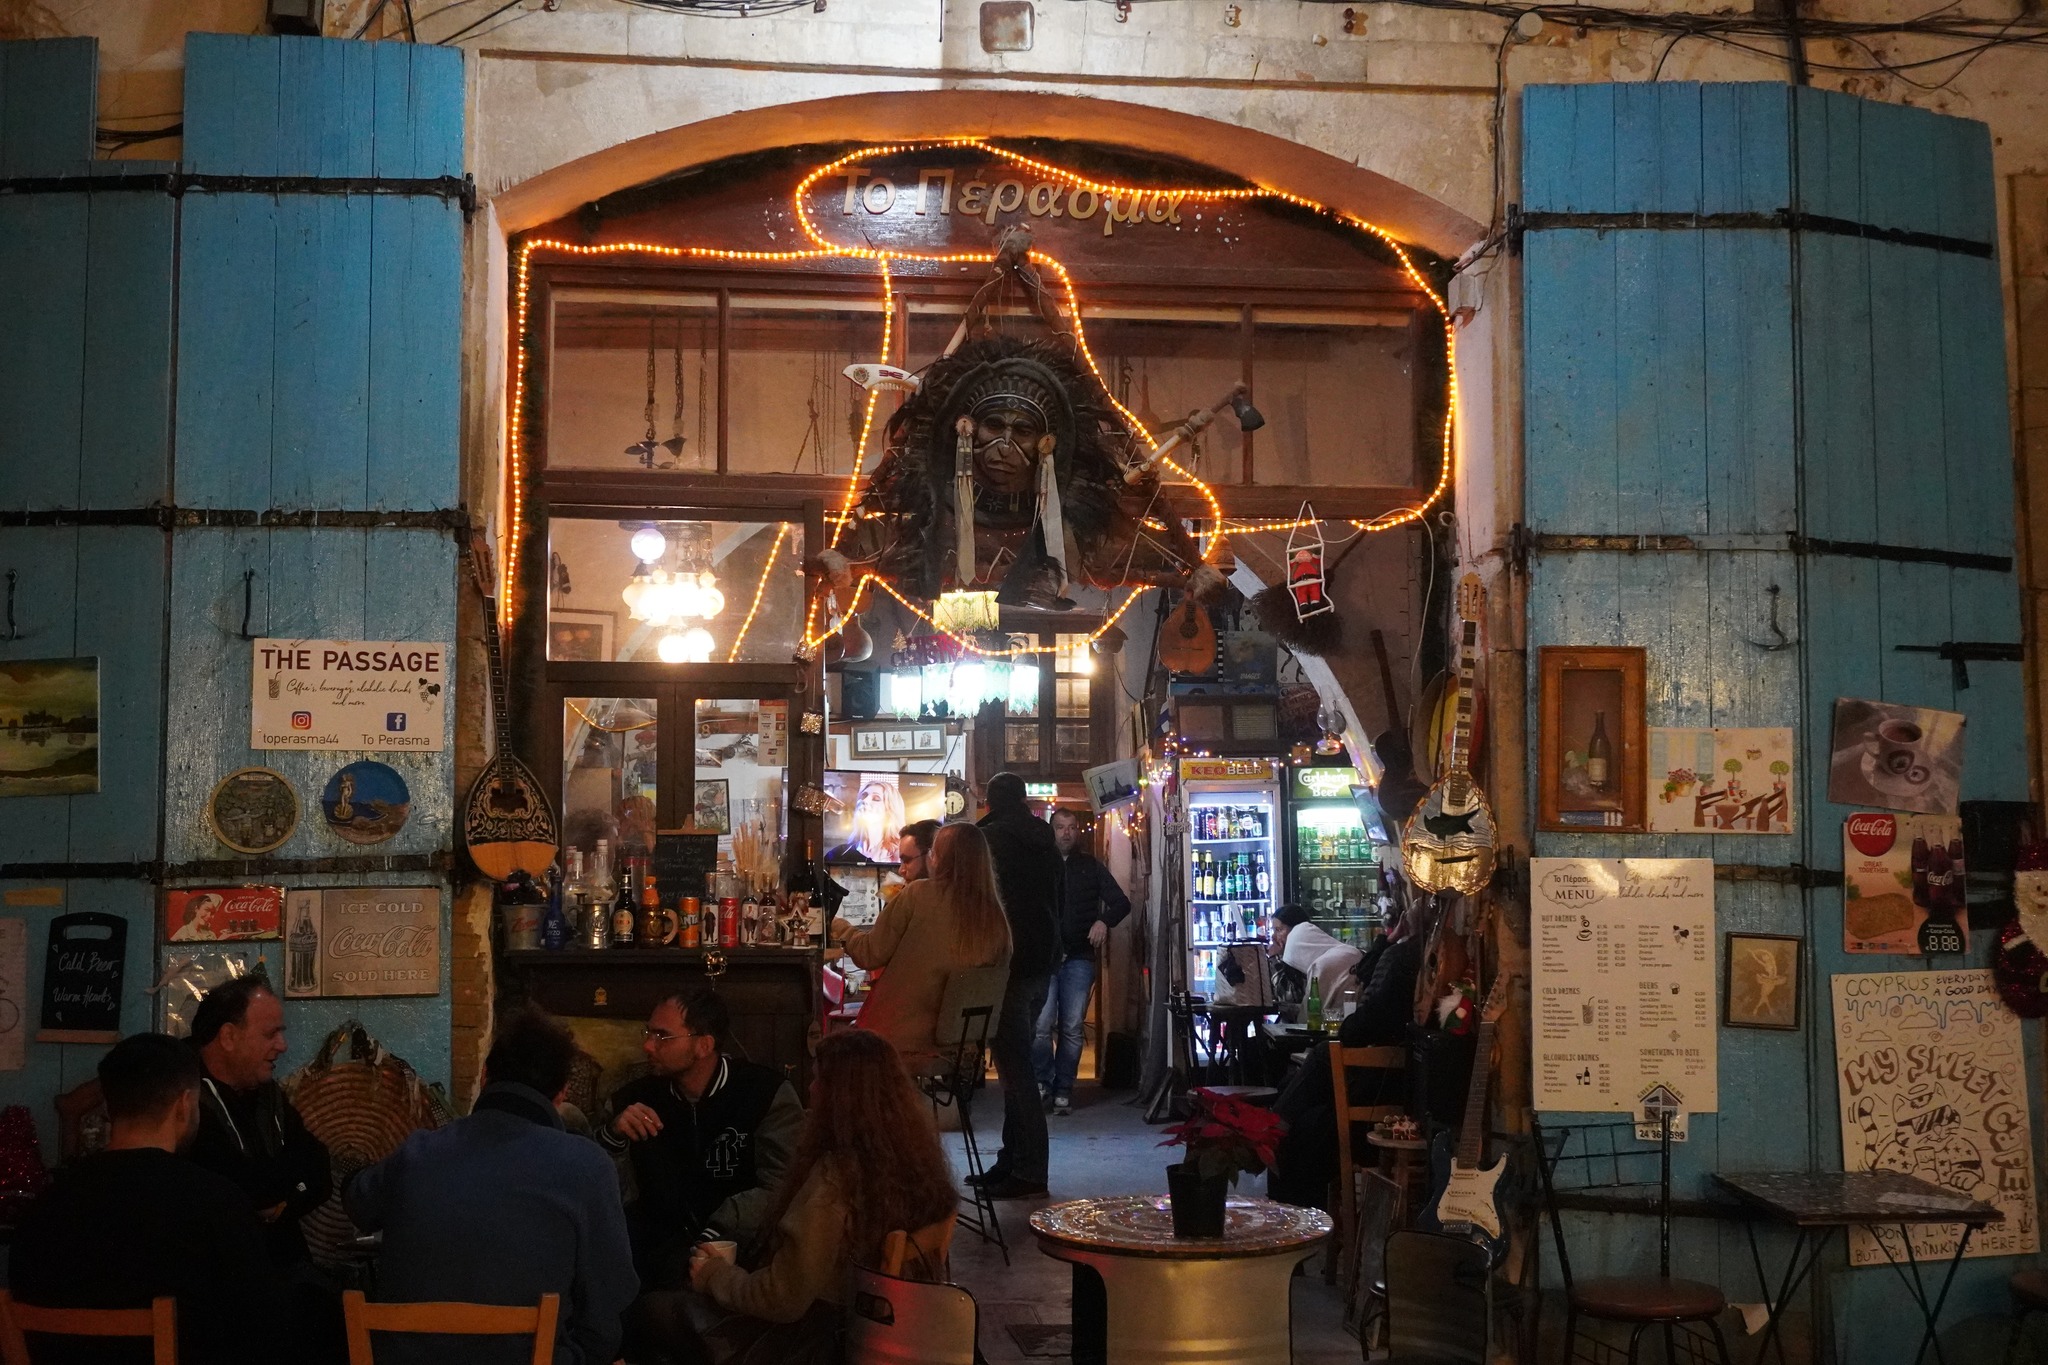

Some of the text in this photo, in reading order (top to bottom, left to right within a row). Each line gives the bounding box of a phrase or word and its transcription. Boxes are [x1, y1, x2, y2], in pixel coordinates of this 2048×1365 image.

[915, 166, 1182, 236] Πέρασμα
[260, 648, 440, 673] THE PASSAGE
[263, 733, 430, 746] toperasma44 To Perasma
[1191, 766, 1263, 775] KEO BEER
[1298, 768, 1350, 787] Carlsberg
[1312, 786, 1337, 797] Beer
[1850, 818, 1894, 836] Coca-Cola
[1555, 889, 1595, 900] MENU
[224, 897, 275, 914] Coca-Cola
[339, 902, 424, 915] ICE COLD
[329, 924, 436, 959] Coca-Cola
[58, 951, 85, 972] Cold
[331, 969, 430, 983] SOLD HERE
[1845, 973, 1990, 997] CCYPRUS EVERYDAY
[1933, 988, 1941, 997] A
[1945, 985, 1974, 996] GOOD
[53, 985, 81, 1003] Warm
[1543, 1053, 1599, 1061] ALCOHOLIC DRINKS
[1843, 1044, 2013, 1104] MY SWEET
[1639, 1130, 1649, 1138] 24
[1924, 1223, 1958, 1239] LIVE
[1855, 1248, 1878, 1262] BUT
[1981, 1235, 2017, 1249] HERE
